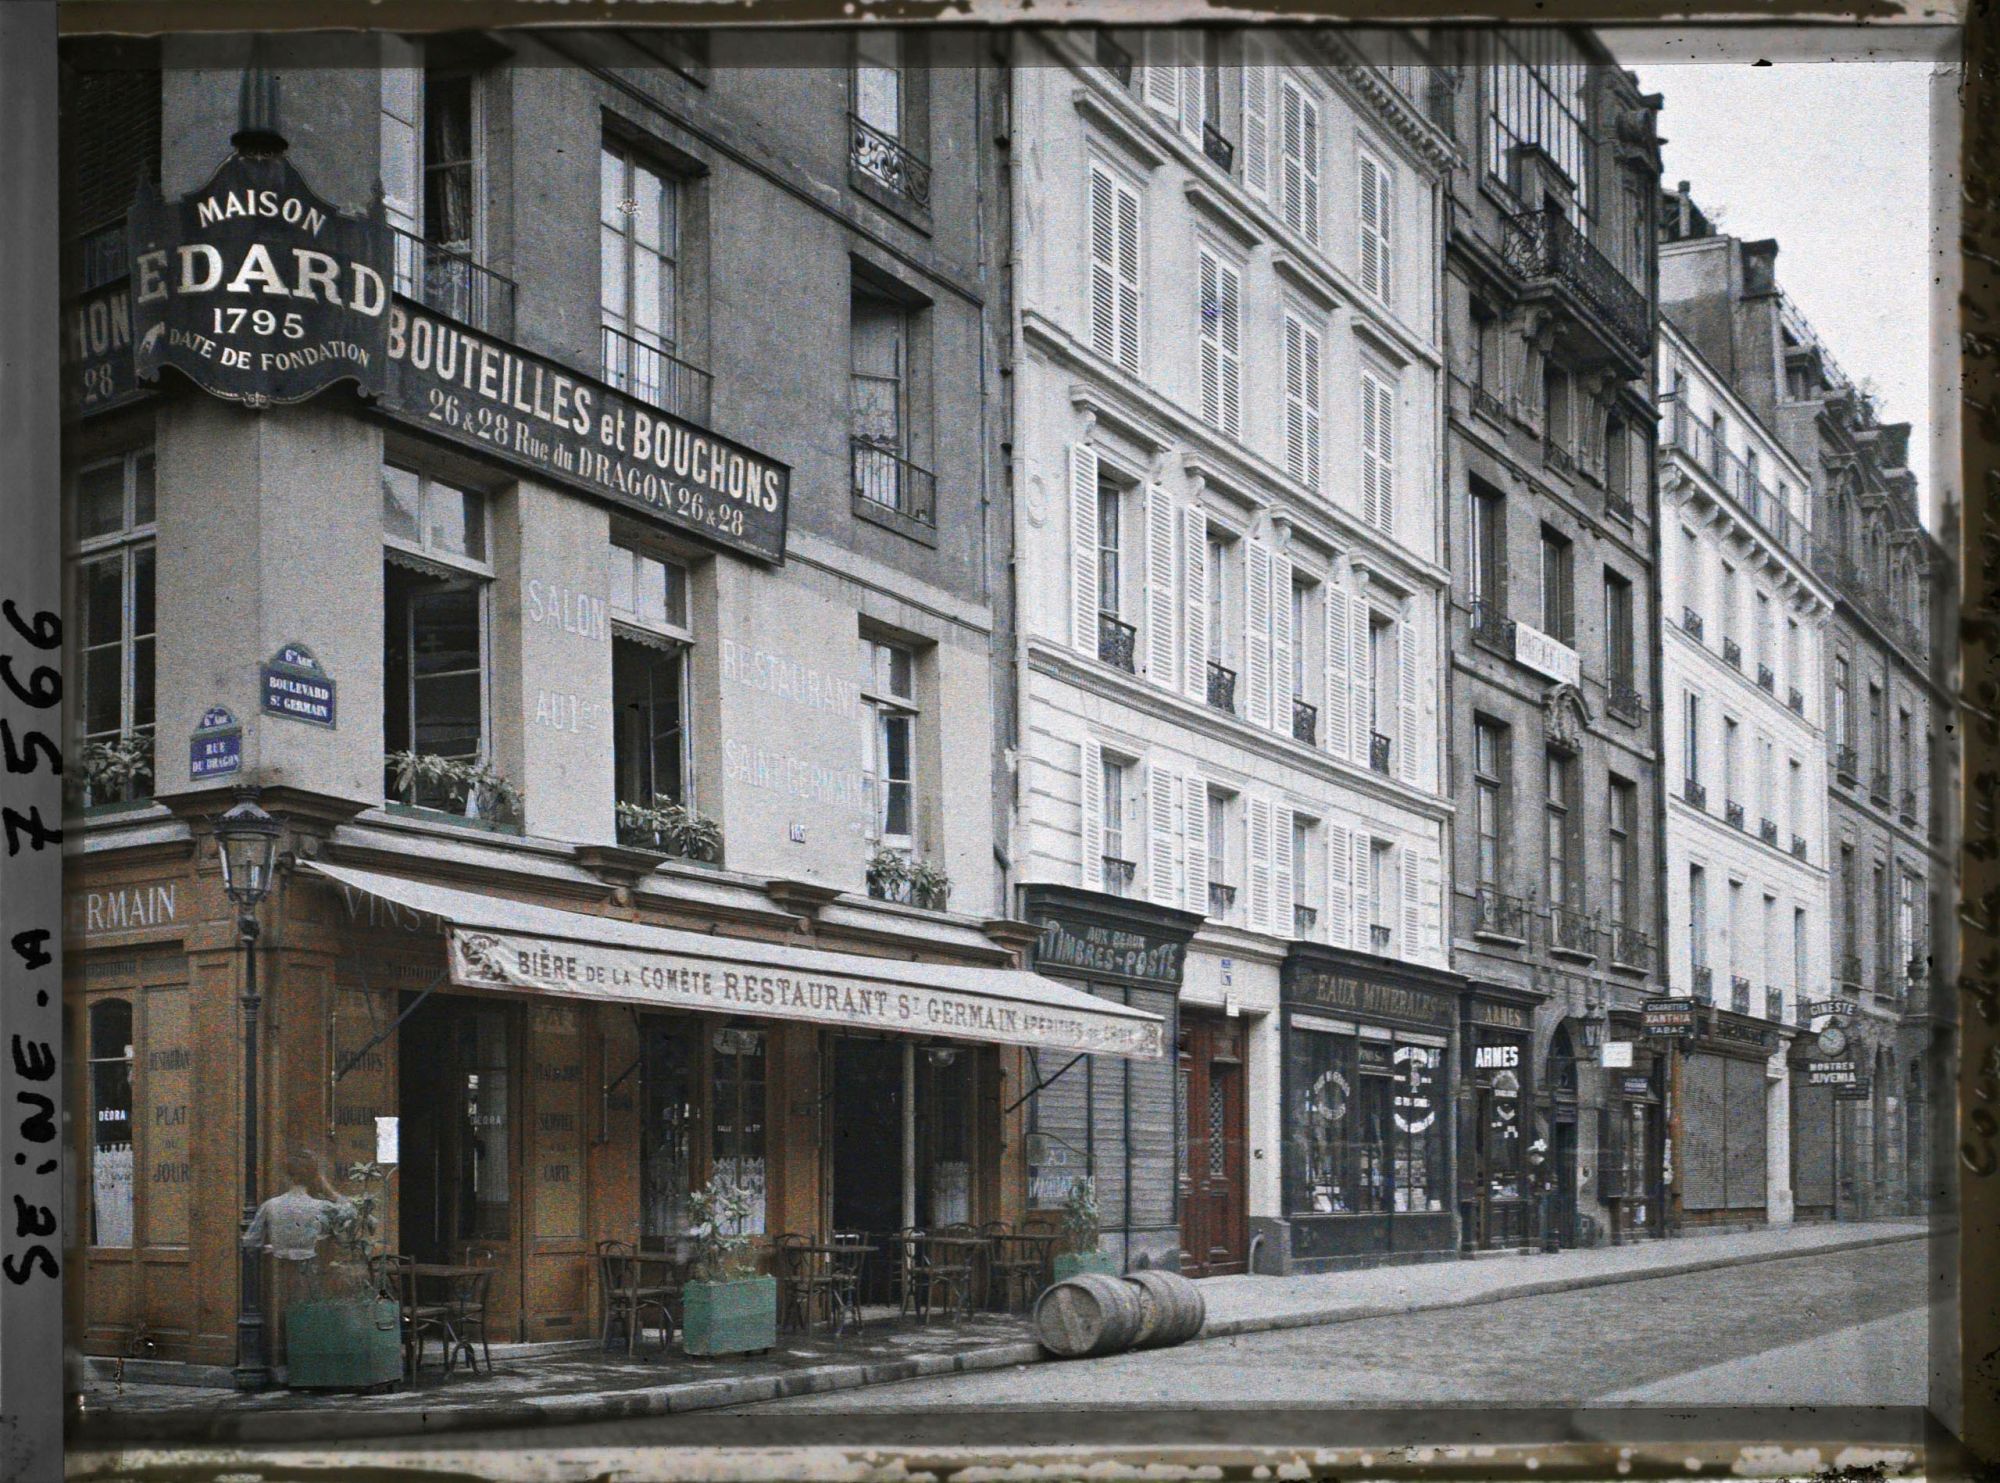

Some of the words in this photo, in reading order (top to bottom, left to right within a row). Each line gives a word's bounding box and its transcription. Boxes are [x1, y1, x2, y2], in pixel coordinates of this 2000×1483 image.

[198, 189, 326, 237] MAISON
[137, 242, 387, 317] ÉDARD
[213, 307, 305, 339] 1795
[169, 328, 216, 359] DATE
[220, 347, 252, 370] DE
[261, 340, 370, 372] FONDATION
[388, 301, 591, 436] BOUTEILLES
[600, 408, 626, 452] et
[634, 410, 779, 513] BOUCHONS
[515, 420, 549, 462] Rue
[553, 440, 573, 471] du
[579, 446, 676, 513] DRAGON
[528, 579, 605, 641] SALON
[269, 676, 329, 700] BOULEVARD
[723, 638, 860, 719] RESTAURANT
[283, 698, 328, 717] GERMAIN
[192, 760, 204, 773] DU
[206, 753, 240, 770] DRAGON
[206, 741, 226, 755] RUE
[517, 947, 577, 981] BIÈRE
[586, 965, 604, 983] DE
[612, 967, 631, 987] LA
[723, 971, 888, 1018] RESTAURANT
[927, 997, 1016, 1032] GERMAIN
[1316, 973, 1358, 1006] EAUX
[1650, 1026, 1685, 1035] TABAC
[1475, 1045, 1519, 1069] ARMES
[1809, 1061, 1855, 1072] MONTRES
[156, 1105, 187, 1127] PLAT
[153, 1163, 190, 1183] JOUR
